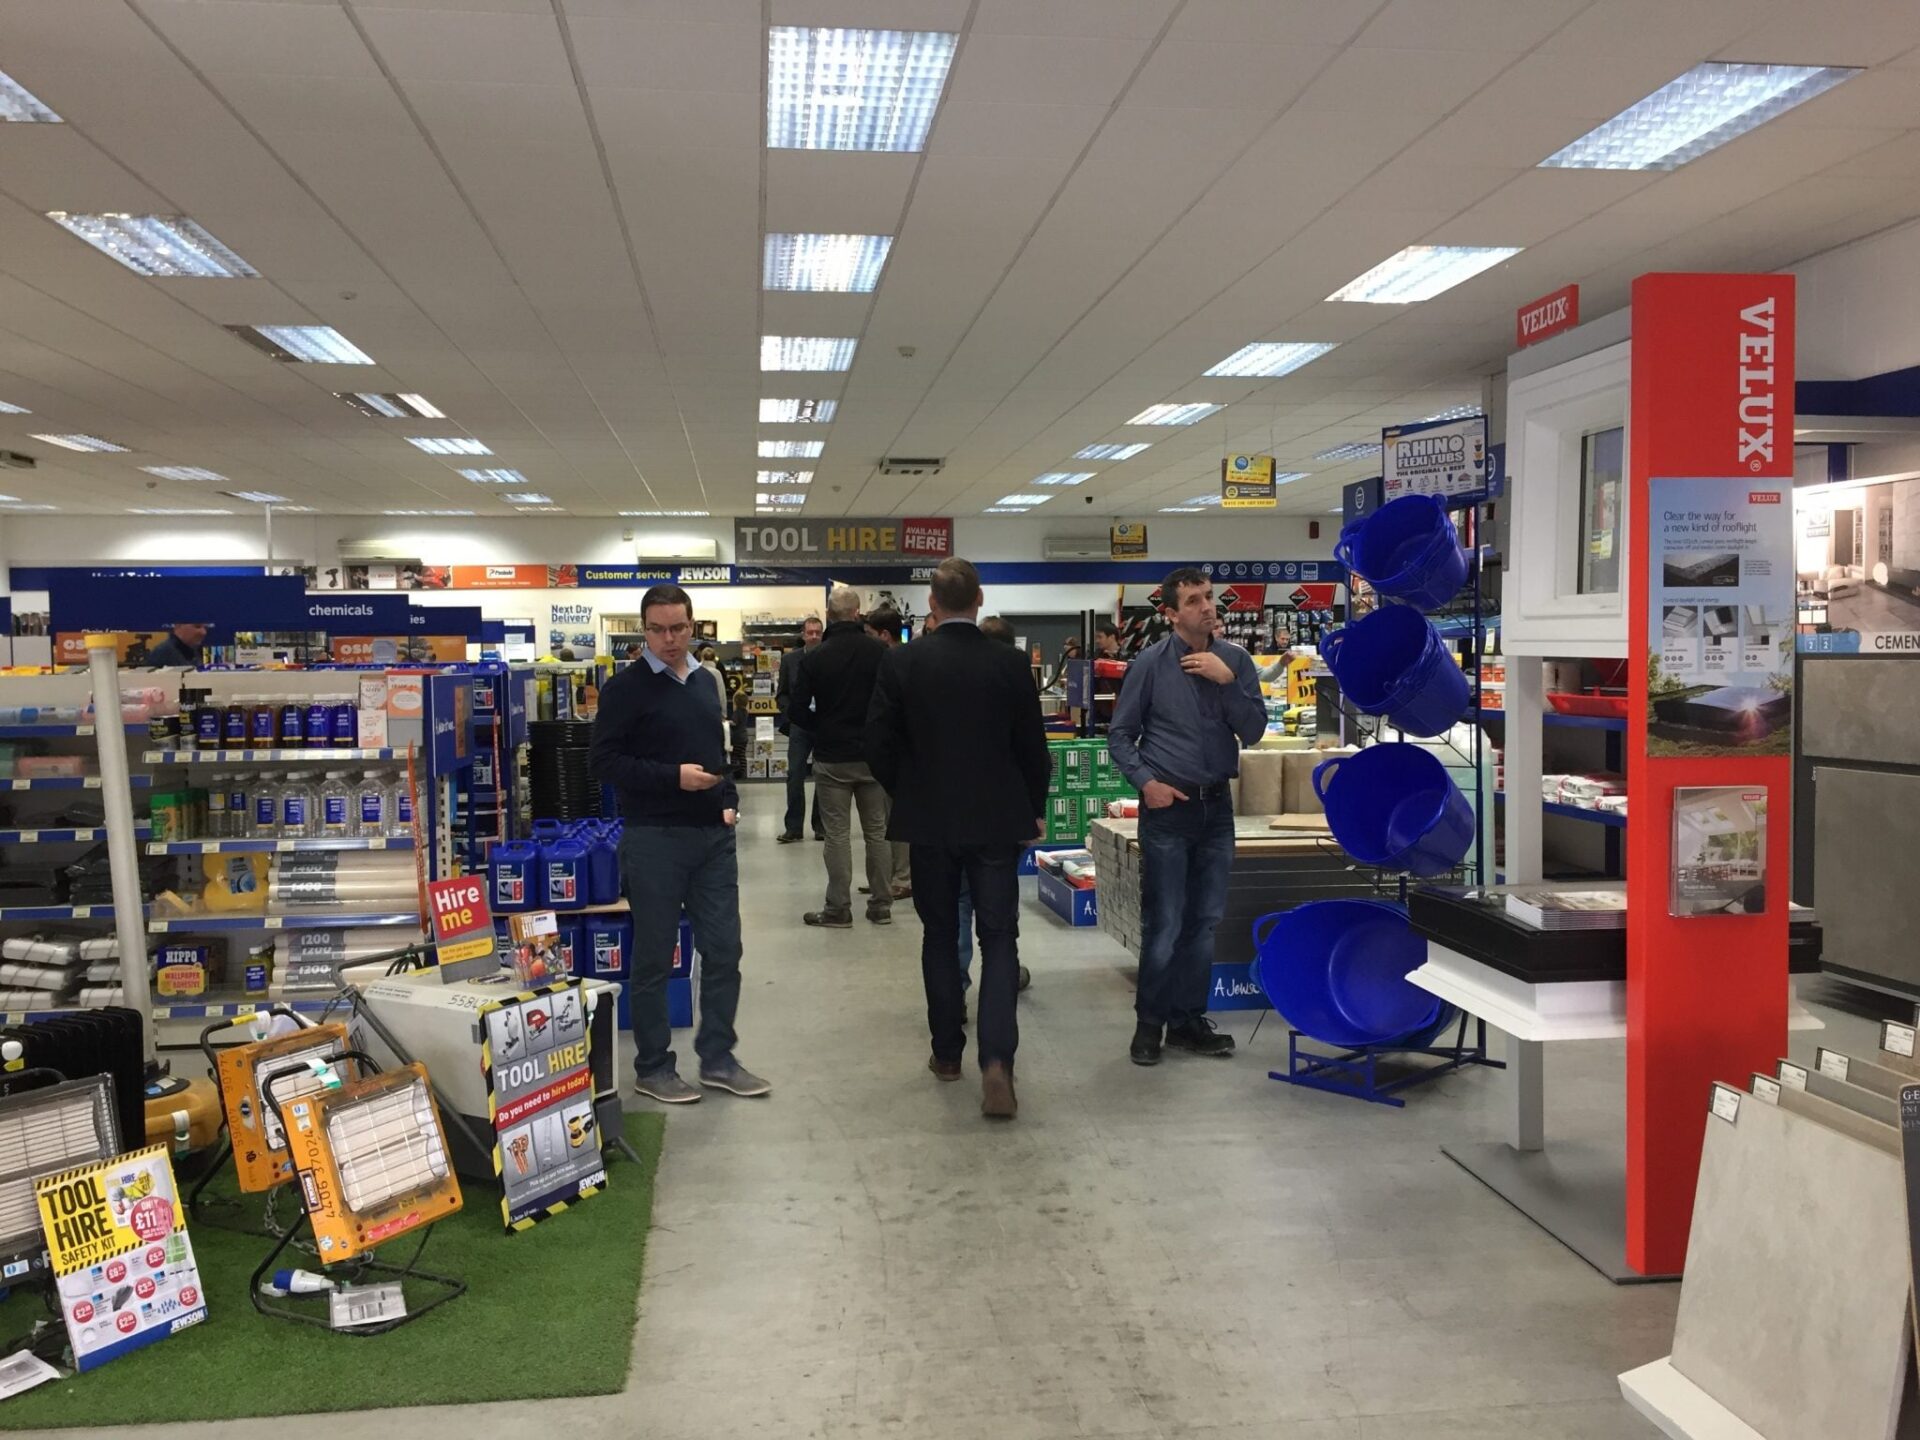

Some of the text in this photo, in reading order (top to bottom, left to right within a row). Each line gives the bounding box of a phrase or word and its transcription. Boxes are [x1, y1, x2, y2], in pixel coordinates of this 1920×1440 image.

[1397, 434, 1464, 460] RHINO
[1397, 450, 1465, 469] FLEXI TUBS
[1663, 510, 1736, 522] Clear the way for
[905, 526, 948, 536] AVAILABLE
[1691, 522, 1709, 532] kind
[1711, 522, 1720, 532] of
[1722, 521, 1757, 534] rooflight
[740, 527, 896, 552] TOOL HIRE
[904, 536, 948, 551] HERE
[585, 570, 672, 581] Customer service
[677, 567, 731, 581] JEWSON
[308, 604, 374, 616] chemicals
[551, 605, 593, 616] Next Day
[551, 613, 592, 624] Delivery
[748, 700, 772, 710] Tool
[435, 886, 480, 913] Hire
[440, 908, 473, 931] me
[301, 933, 330, 946] 1200
[165, 951, 198, 964] HIPPO
[164, 971, 200, 981] WALLPAPER
[497, 1042, 586, 1092] TOOL HIRE
[498, 1111, 509, 1122] Do
[510, 1106, 523, 1120] you
[524, 1095, 541, 1112] need
[552, 1084, 566, 1098] hire
[567, 1073, 589, 1092] today?
[578, 1169, 605, 1192] JEWSON
[41, 1177, 107, 1221] TOOL
[54, 1207, 113, 1252] HIRE
[61, 1234, 117, 1266] SAFETY KIT
[171, 1310, 205, 1331] JEWSON
